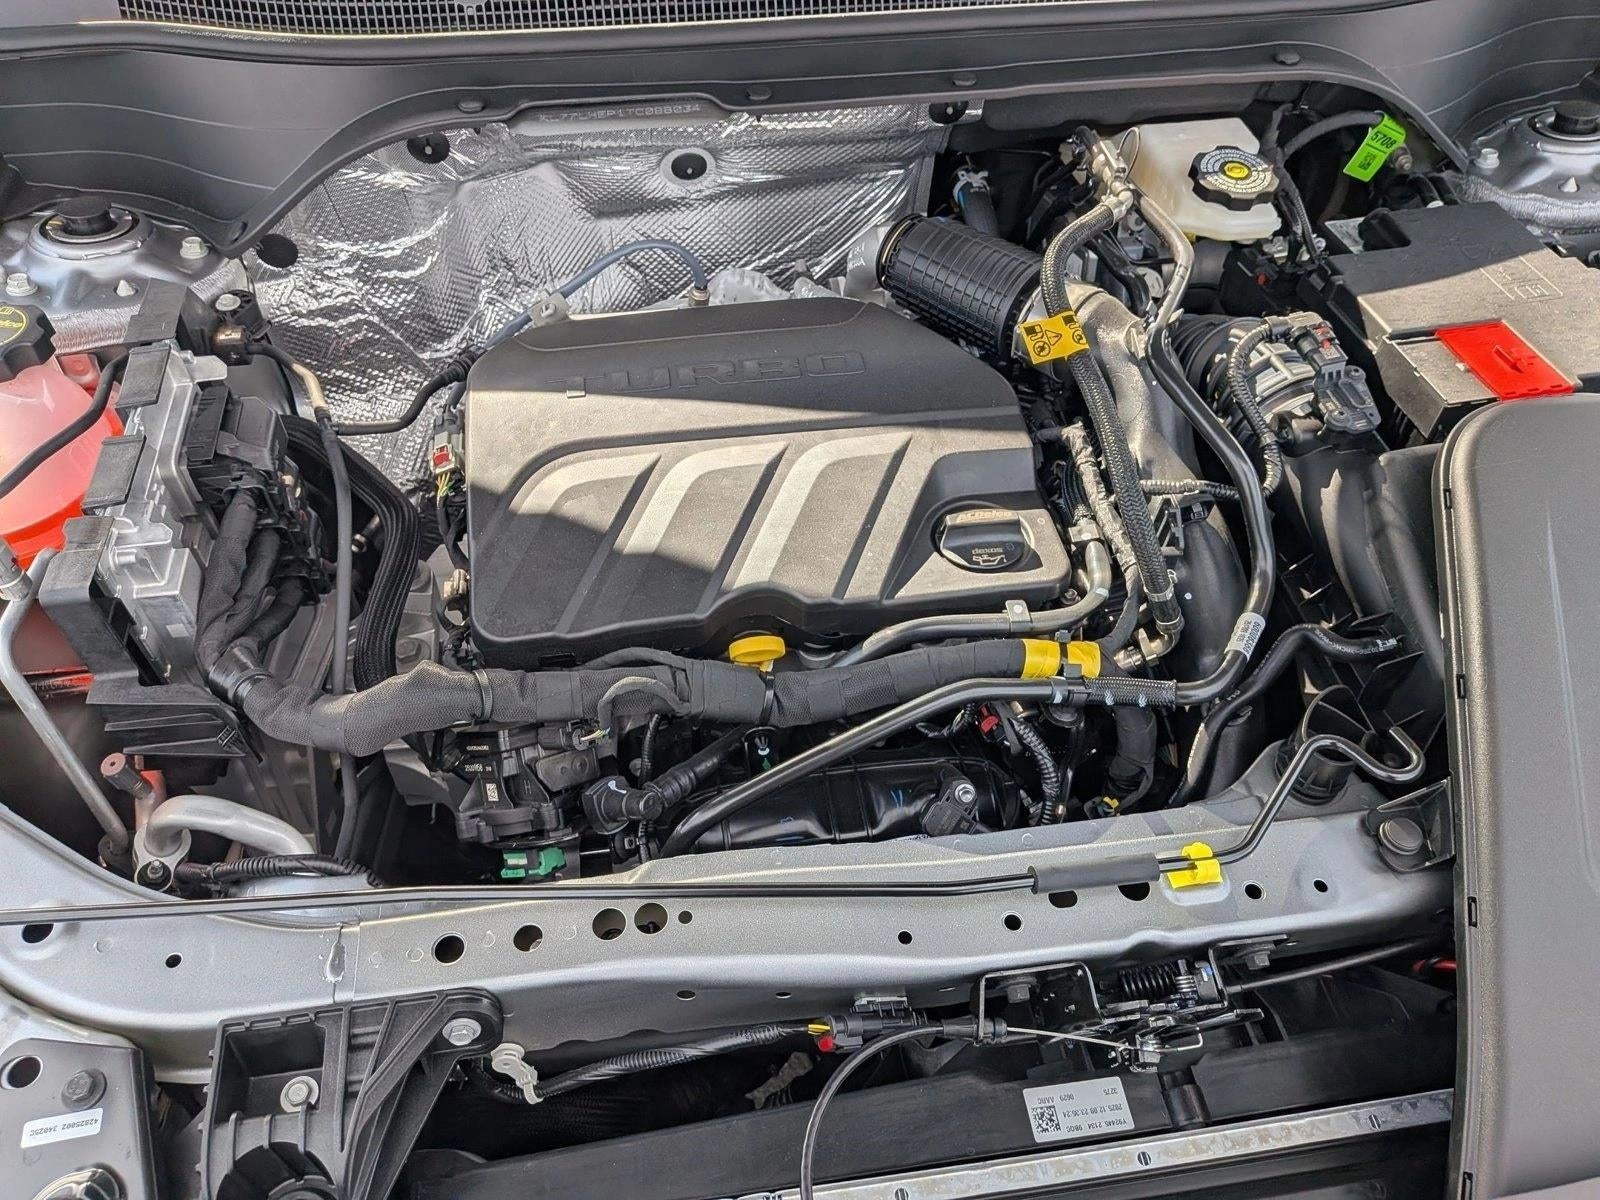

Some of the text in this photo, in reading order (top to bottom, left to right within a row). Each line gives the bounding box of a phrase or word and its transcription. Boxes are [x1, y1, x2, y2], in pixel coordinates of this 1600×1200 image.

[1370, 130, 1397, 149] 5708
[545, 351, 866, 398] TURBO
[972, 546, 1004, 555] dexos
[1103, 1087, 1118, 1096] 3275
